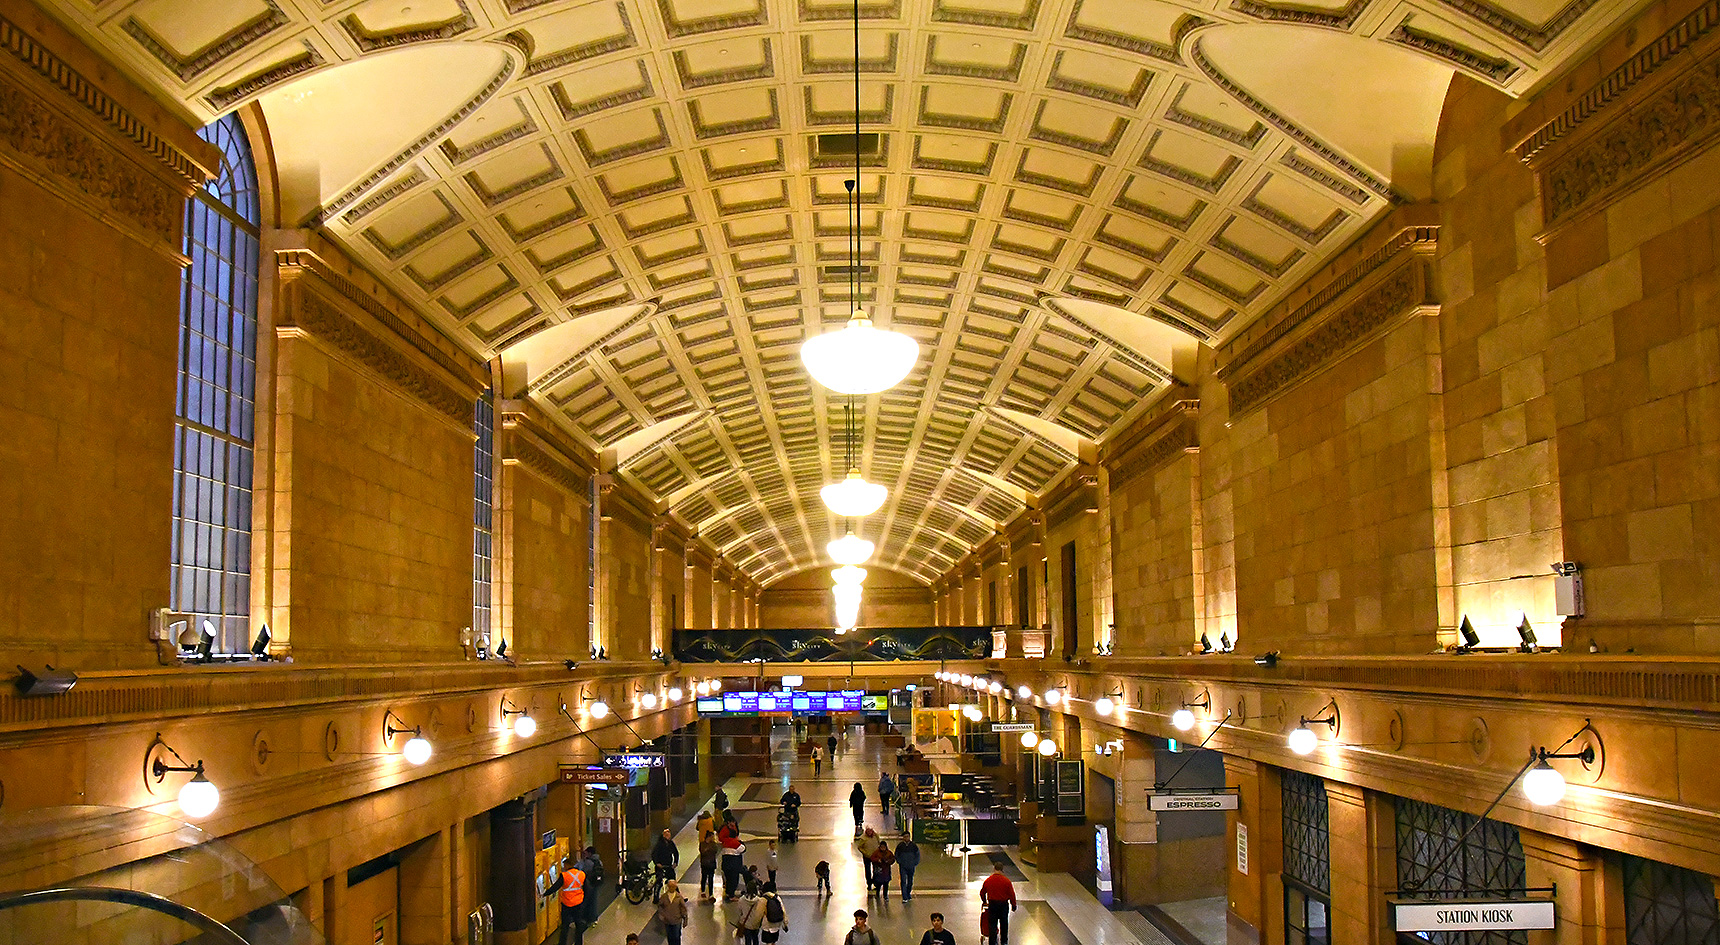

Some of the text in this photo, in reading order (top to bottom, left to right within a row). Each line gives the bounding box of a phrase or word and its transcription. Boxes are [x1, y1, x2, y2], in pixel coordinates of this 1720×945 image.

[1166, 801, 1222, 809] ESPRESSO
[1436, 909, 1514, 924] STATION KIOSK
